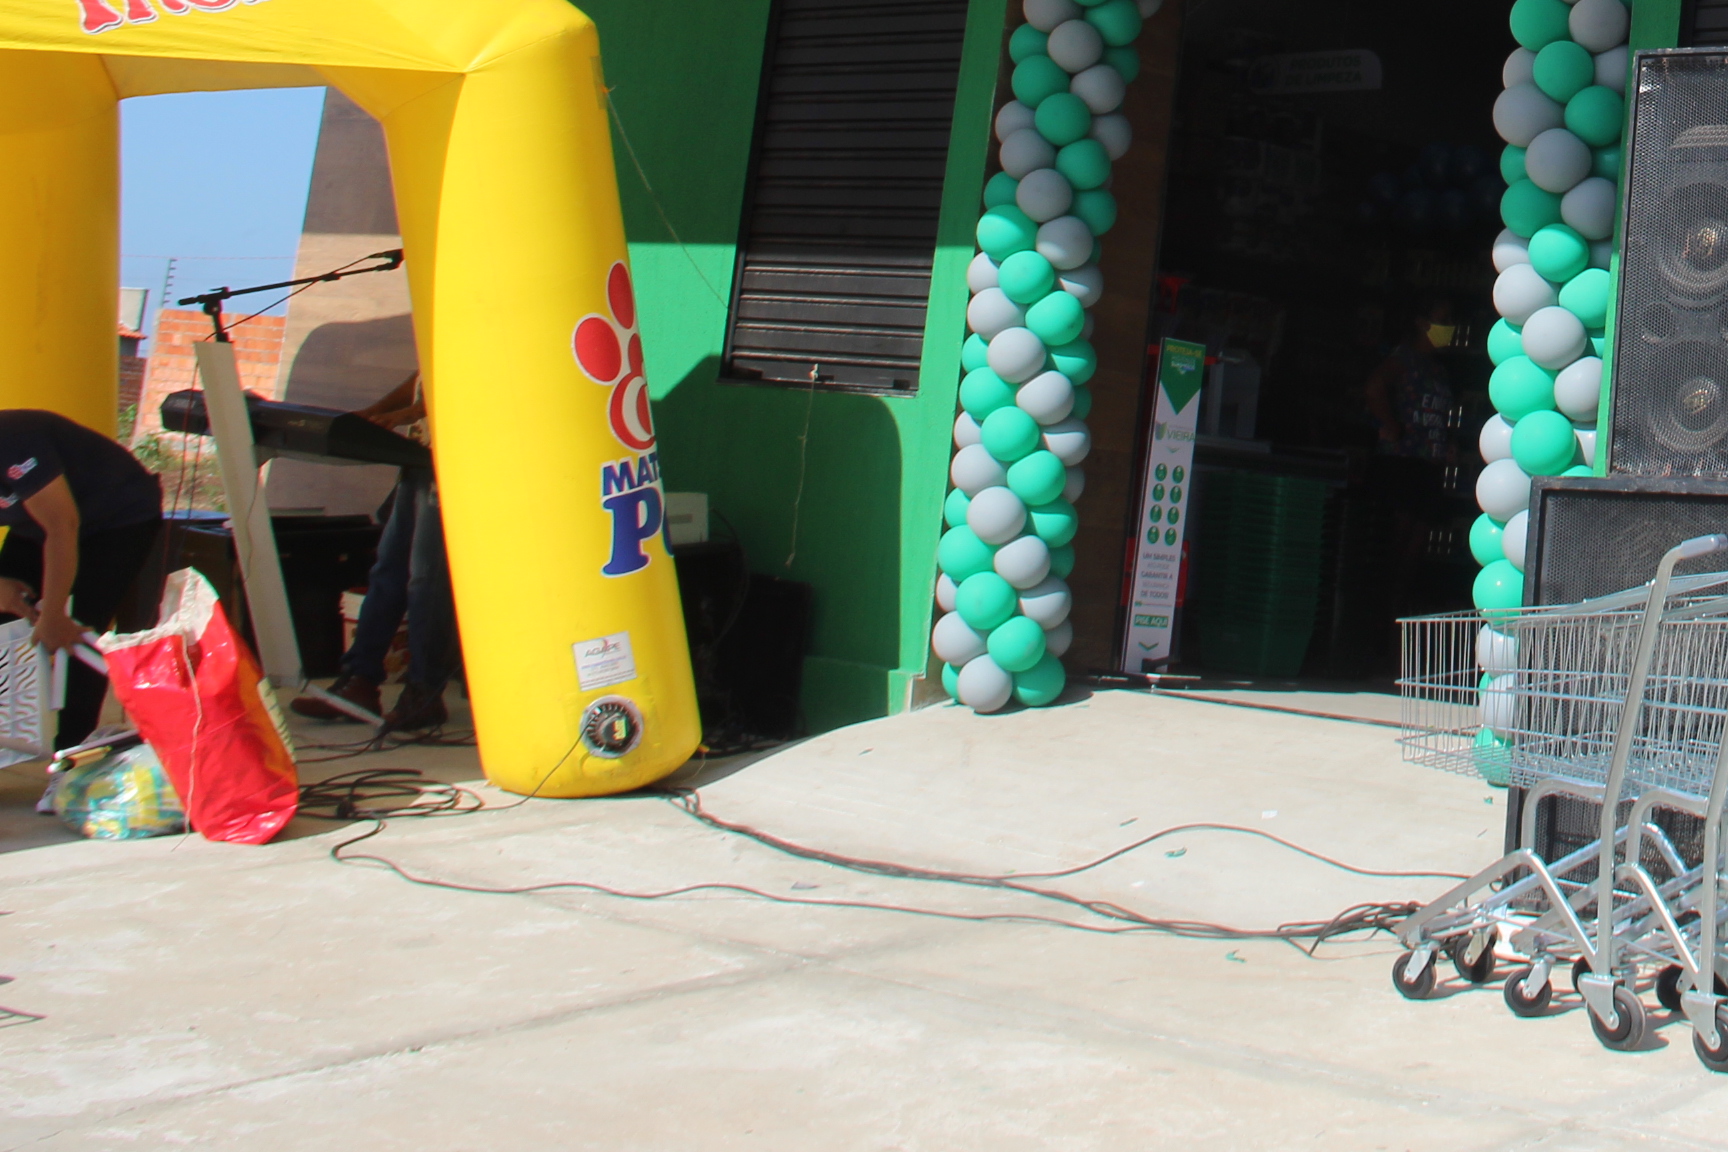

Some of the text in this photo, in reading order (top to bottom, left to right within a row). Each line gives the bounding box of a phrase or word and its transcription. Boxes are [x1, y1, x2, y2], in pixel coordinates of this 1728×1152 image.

[1290, 55, 1362, 69] PRODUTOS
[1285, 71, 1362, 86] DE LIMPEZA
[1167, 429, 1195, 442] VIEIRA
[602, 486, 674, 577] P
